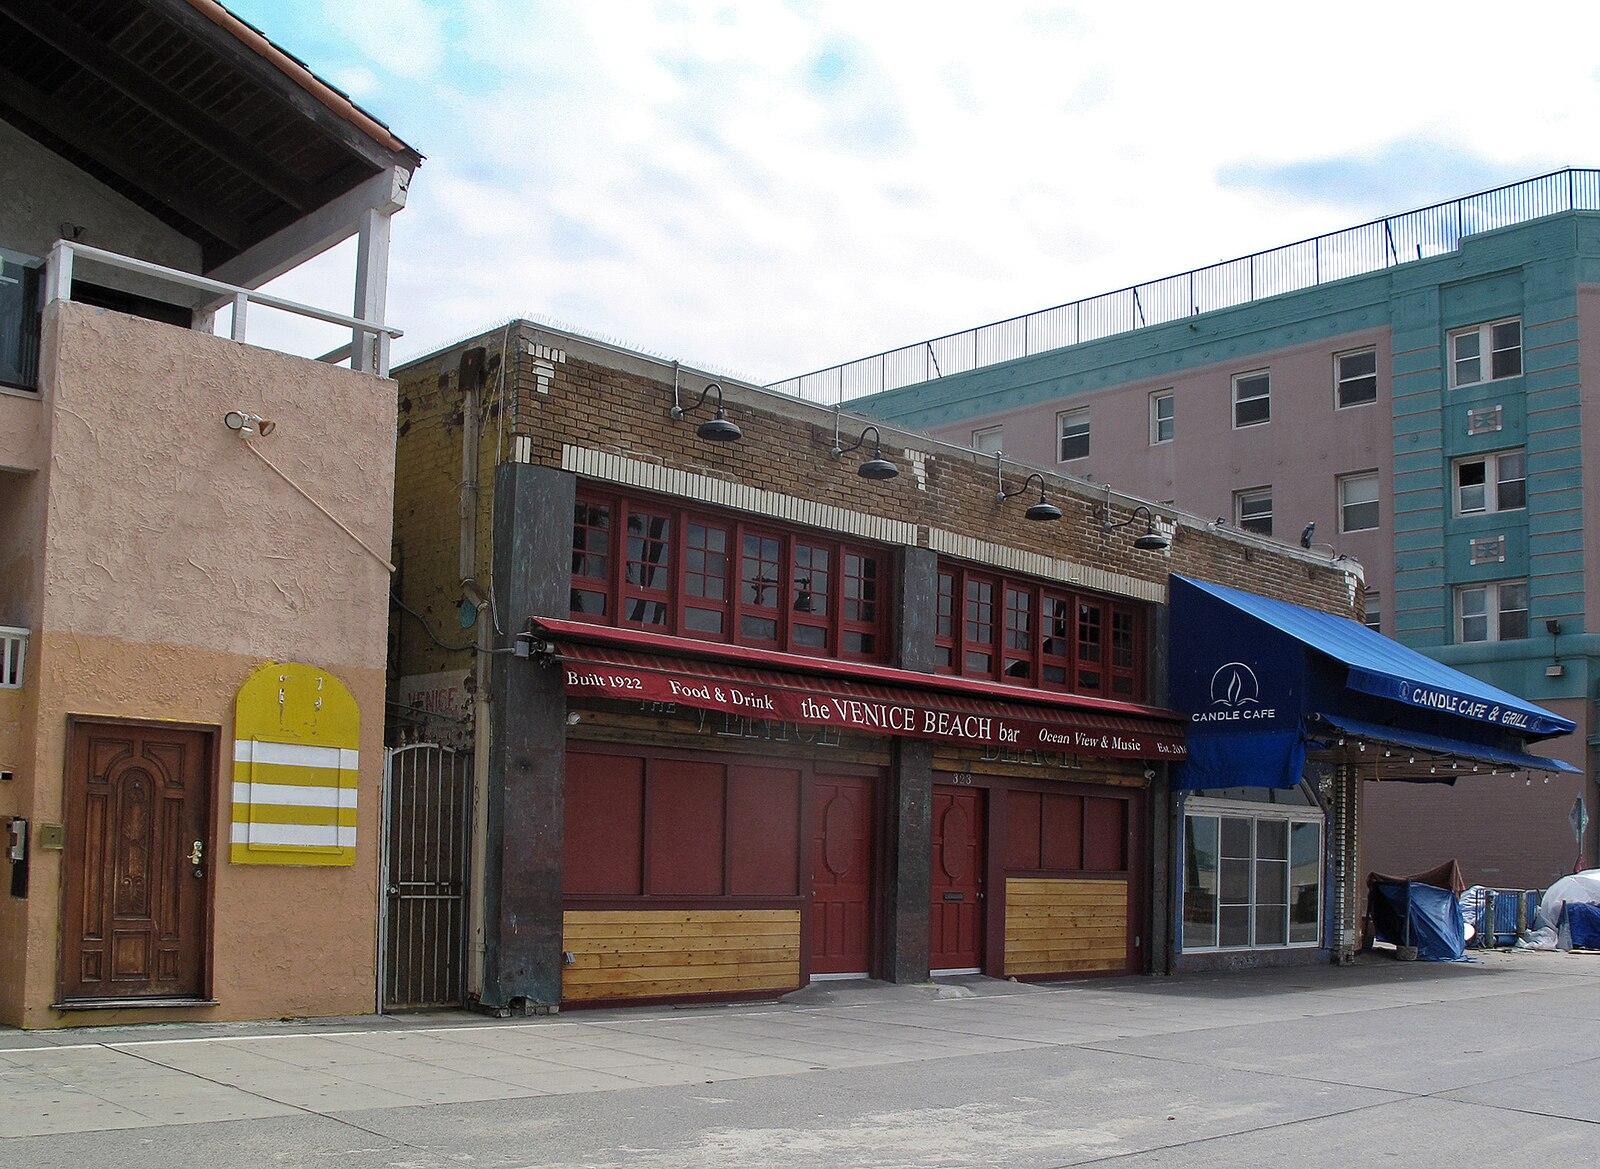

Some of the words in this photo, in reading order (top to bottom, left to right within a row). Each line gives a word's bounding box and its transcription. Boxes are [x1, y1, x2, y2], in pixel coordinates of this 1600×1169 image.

[566, 671, 606, 687] Built
[608, 675, 643, 690] 1922
[668, 680, 711, 700] Food
[714, 687, 728, 703] &
[731, 689, 775, 710] Drink
[1191, 710, 1240, 722] CANDLE
[1243, 709, 1276, 719] CAFE
[1412, 688, 1458, 712] CANDLE
[1458, 700, 1488, 718] CAFE
[1488, 705, 1500, 722] &
[1501, 711, 1529, 728] GRILL
[801, 698, 831, 720] the
[831, 698, 916, 732] VENICE
[922, 710, 992, 740] BEACH
[999, 722, 1021, 743] bar
[1038, 727, 1070, 745] Ocean
[1074, 731, 1099, 747] View
[1100, 735, 1109, 749] &
[1111, 736, 1142, 751] Music
[953, 773, 971, 785] 323
